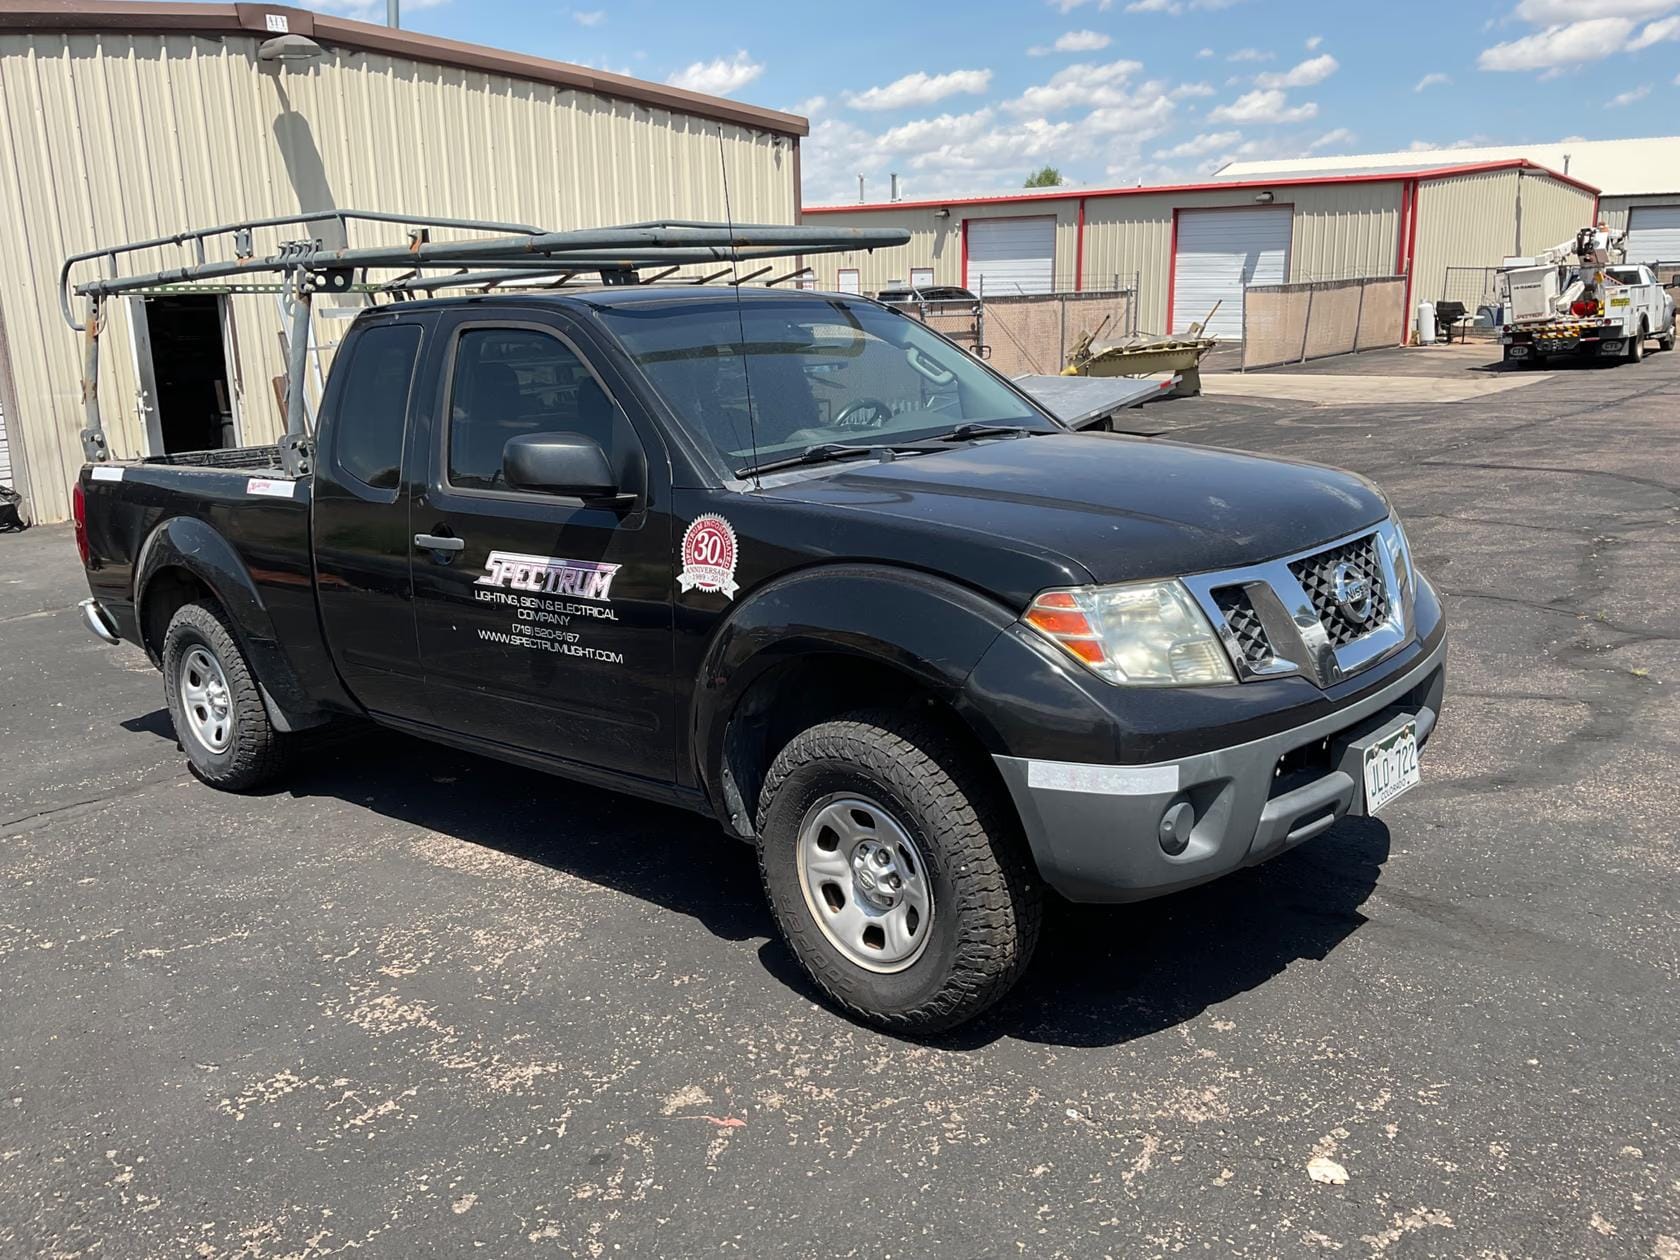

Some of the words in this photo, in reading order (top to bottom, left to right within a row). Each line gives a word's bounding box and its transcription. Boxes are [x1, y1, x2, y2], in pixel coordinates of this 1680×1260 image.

[704, 520, 731, 569] INCORPORATED
[473, 550, 623, 602] SPECTRUM
[686, 567, 729, 577] ANNIVERSARY
[474, 590, 520, 608] LIGHTING,
[520, 596, 545, 609] SIGN
[545, 601, 554, 611] &
[554, 602, 619, 621] ELECTRICAL
[517, 608, 571, 626] COMPANY
[477, 628, 624, 664] WWW.SPECTRUMLIGHT.COM
[511, 623, 534, 636] (719)
[534, 626, 580, 643] 520-5167
[1381, 778, 1407, 801] COLORADO
